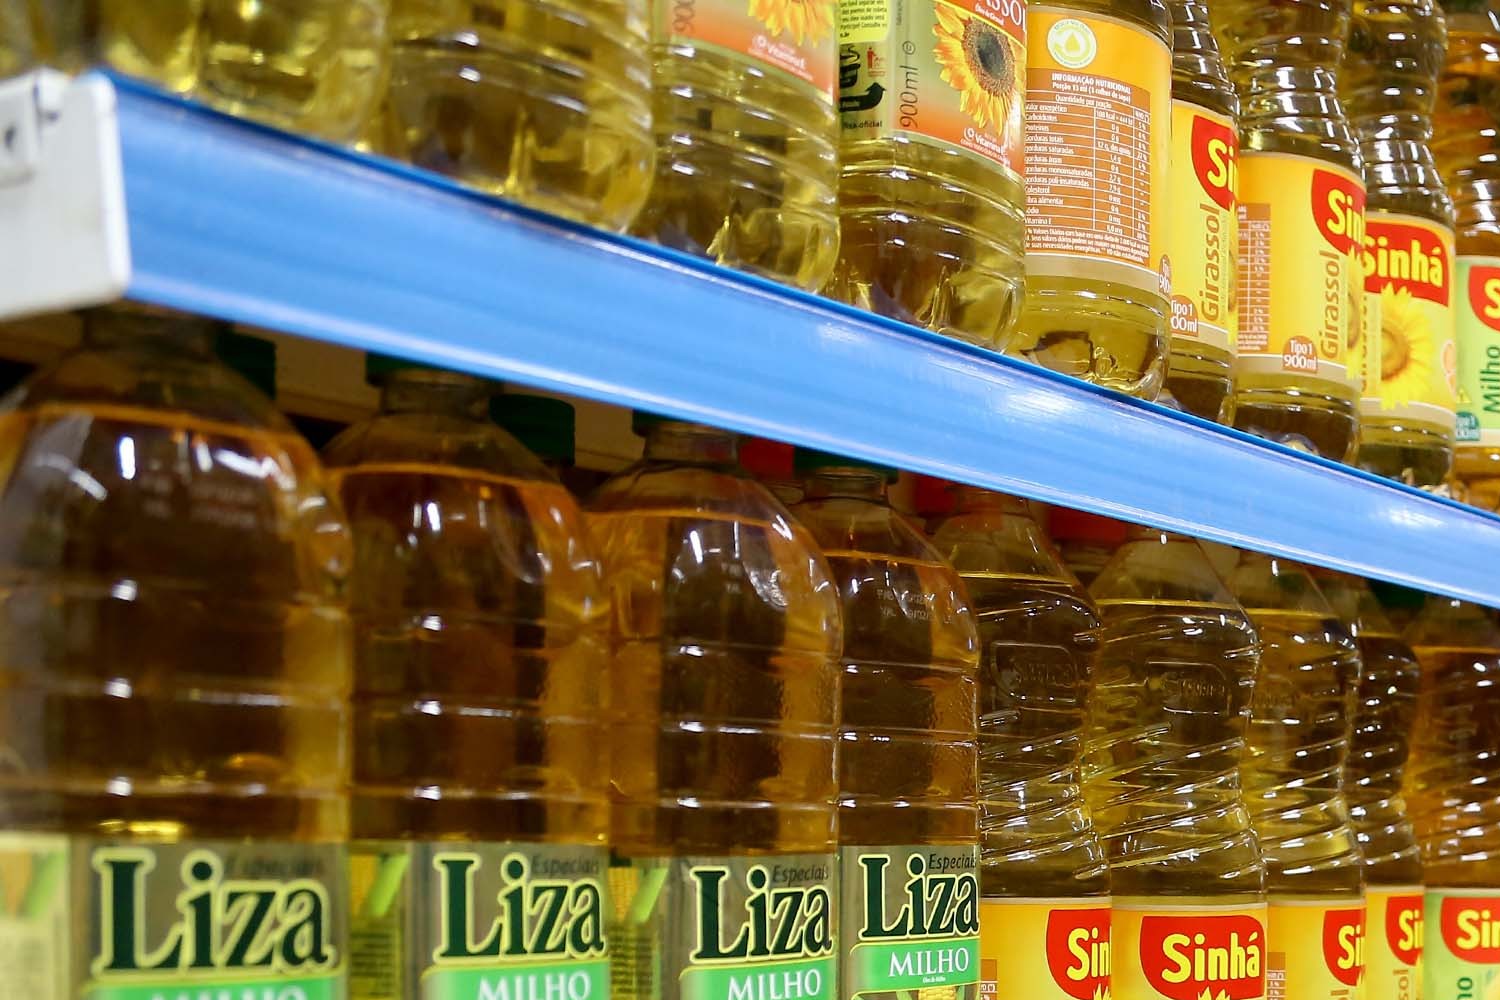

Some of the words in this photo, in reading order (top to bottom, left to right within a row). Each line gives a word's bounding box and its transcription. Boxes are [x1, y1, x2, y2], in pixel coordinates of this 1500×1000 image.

[899, 65, 919, 128] 900ml
[1052, 72, 1094, 85] INFORMAÇÃO
[1095, 79, 1131, 94] NUTRICIONAL
[1055, 94, 1085, 105] Quantidade
[1200, 203, 1220, 322] Girassol
[1170, 315, 1198, 334] 00ml
[1319, 250, 1340, 360] Girassol
[1284, 353, 1318, 371] 900ml
[1290, 337, 1307, 354] Tipo
[97, 854, 334, 973] Liza
[436, 856, 605, 960] Liza
[692, 867, 833, 961] Liza
[860, 855, 980, 939] Liza
[889, 948, 969, 977] MILHO
[1067, 926, 1112, 982] Sin
[1161, 931, 1260, 984] Sinhá
